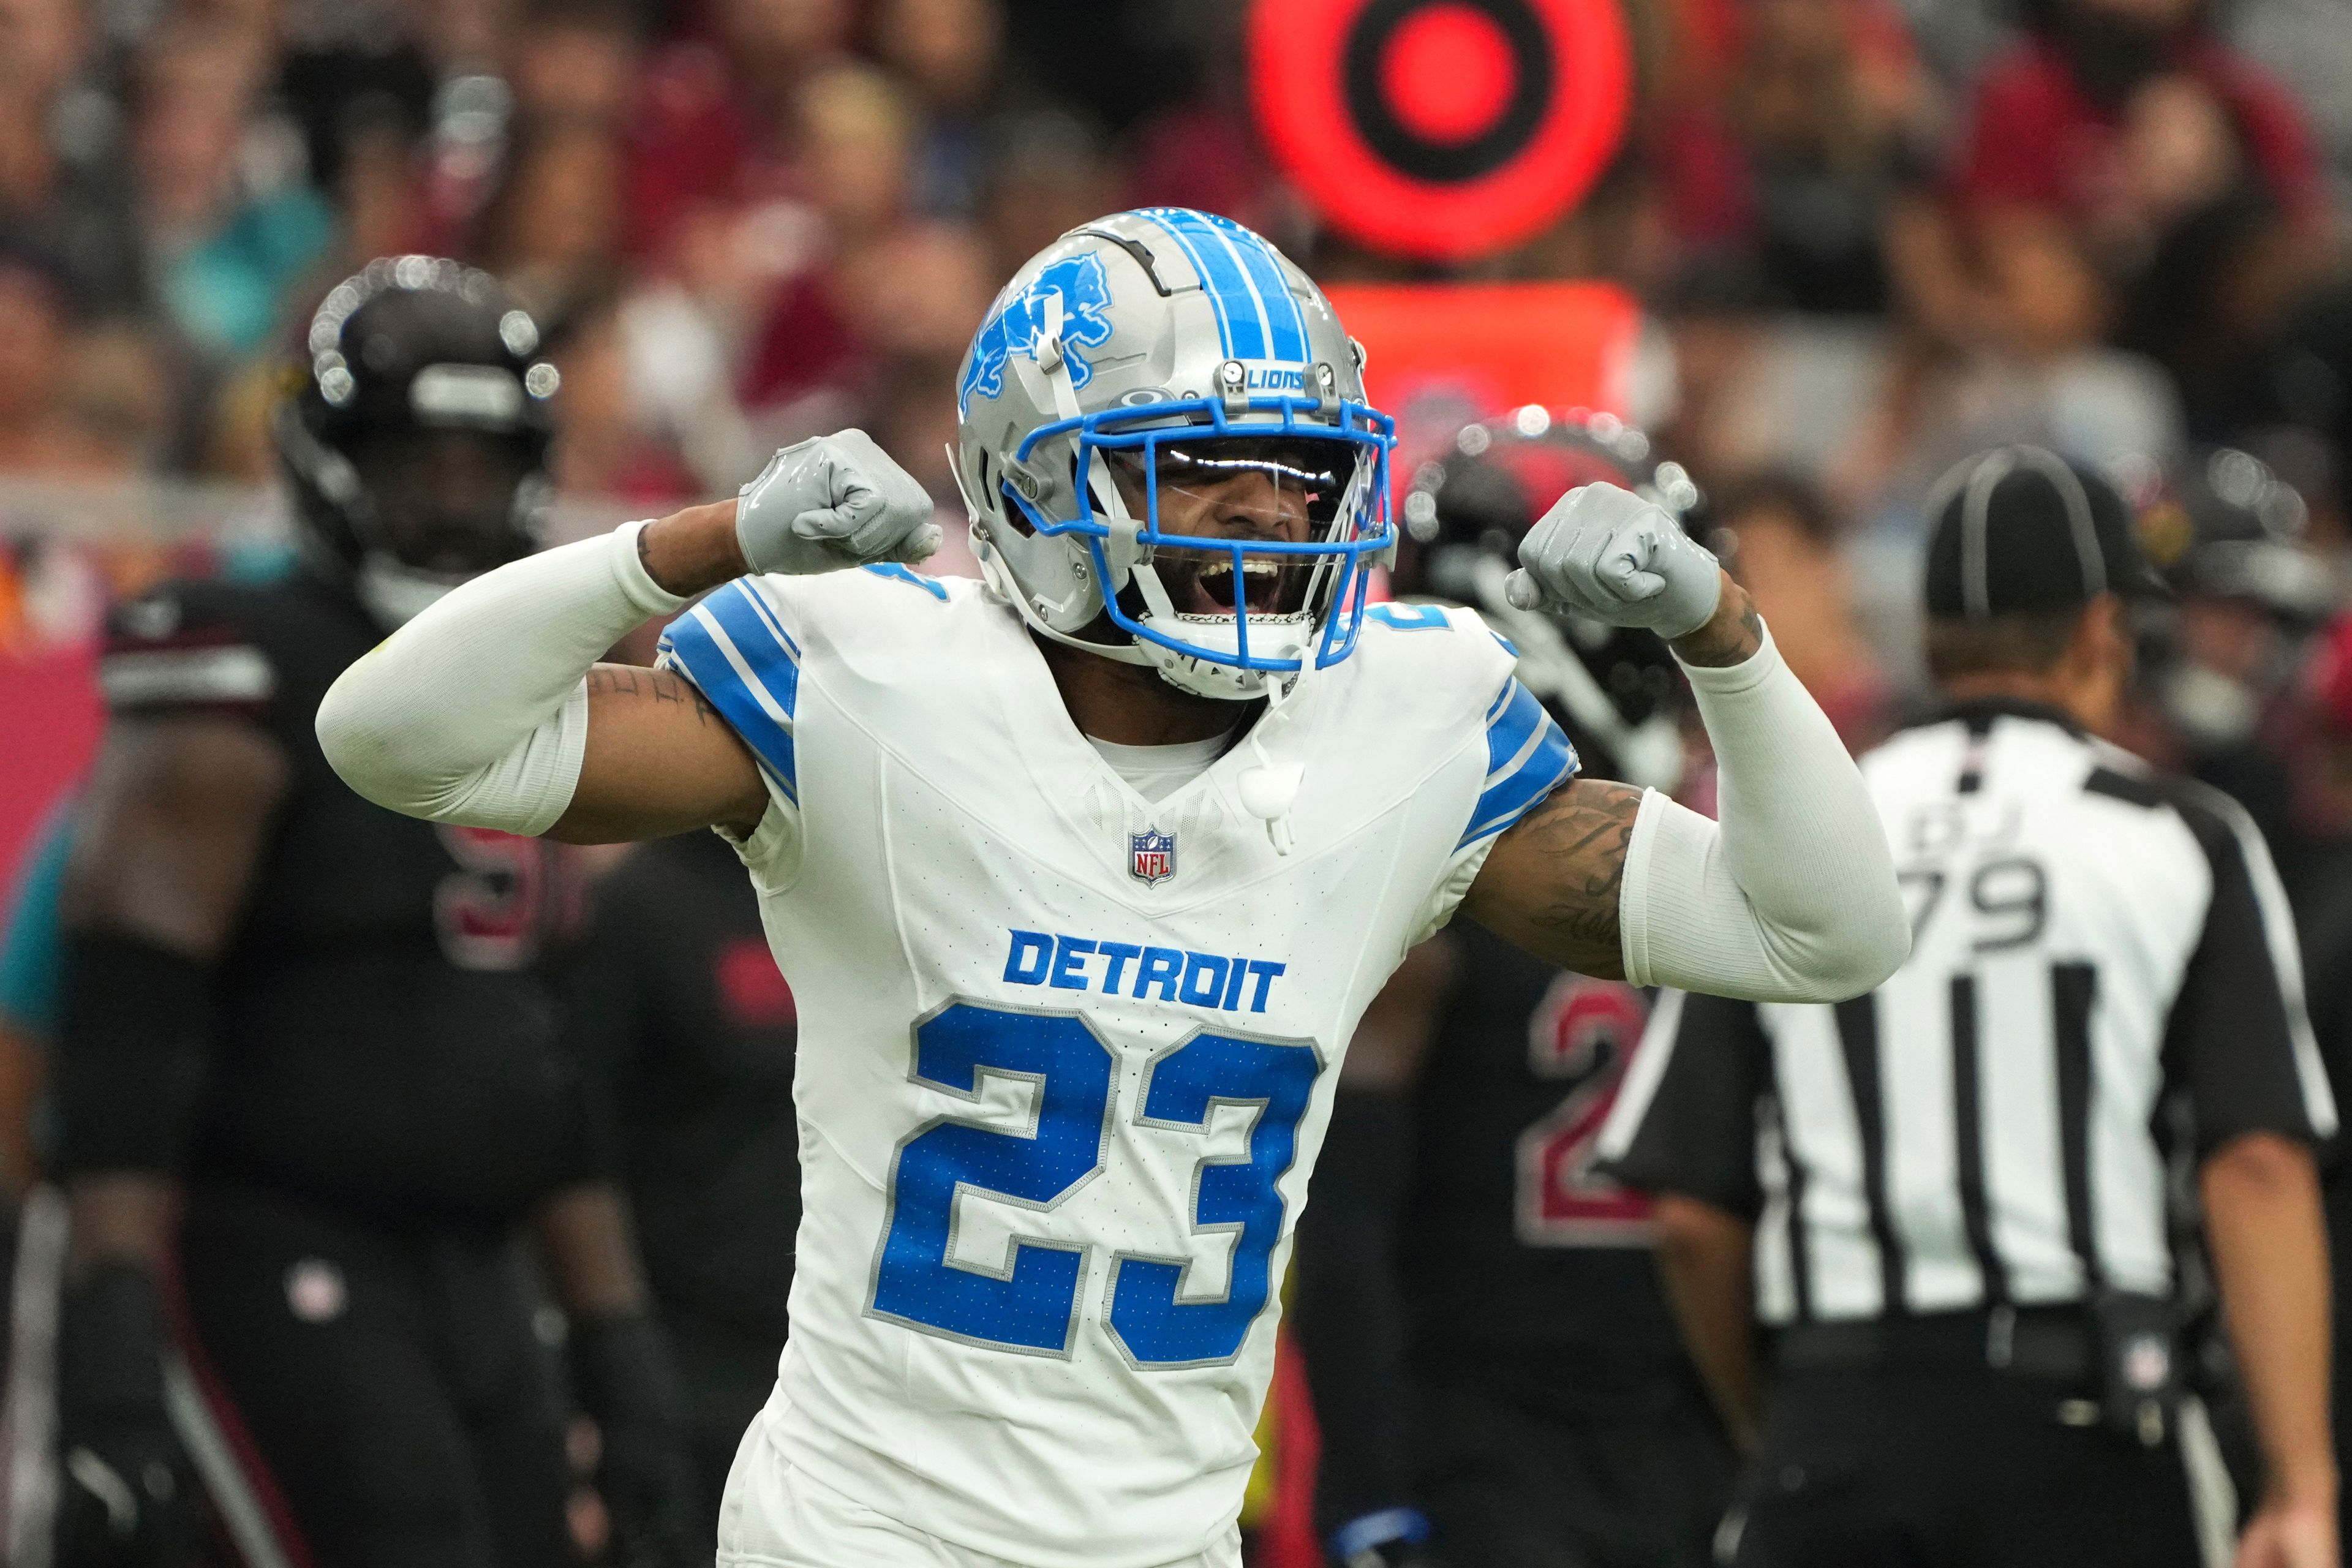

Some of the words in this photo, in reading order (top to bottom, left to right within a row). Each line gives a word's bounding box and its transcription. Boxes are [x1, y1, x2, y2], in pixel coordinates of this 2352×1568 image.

[1247, 369, 1303, 389] LIONS
[1136, 853, 1169, 877] NFL
[1897, 856, 2051, 957] 79
[1003, 929, 1287, 1012] DETROIT
[861, 993, 1327, 1371] 23
